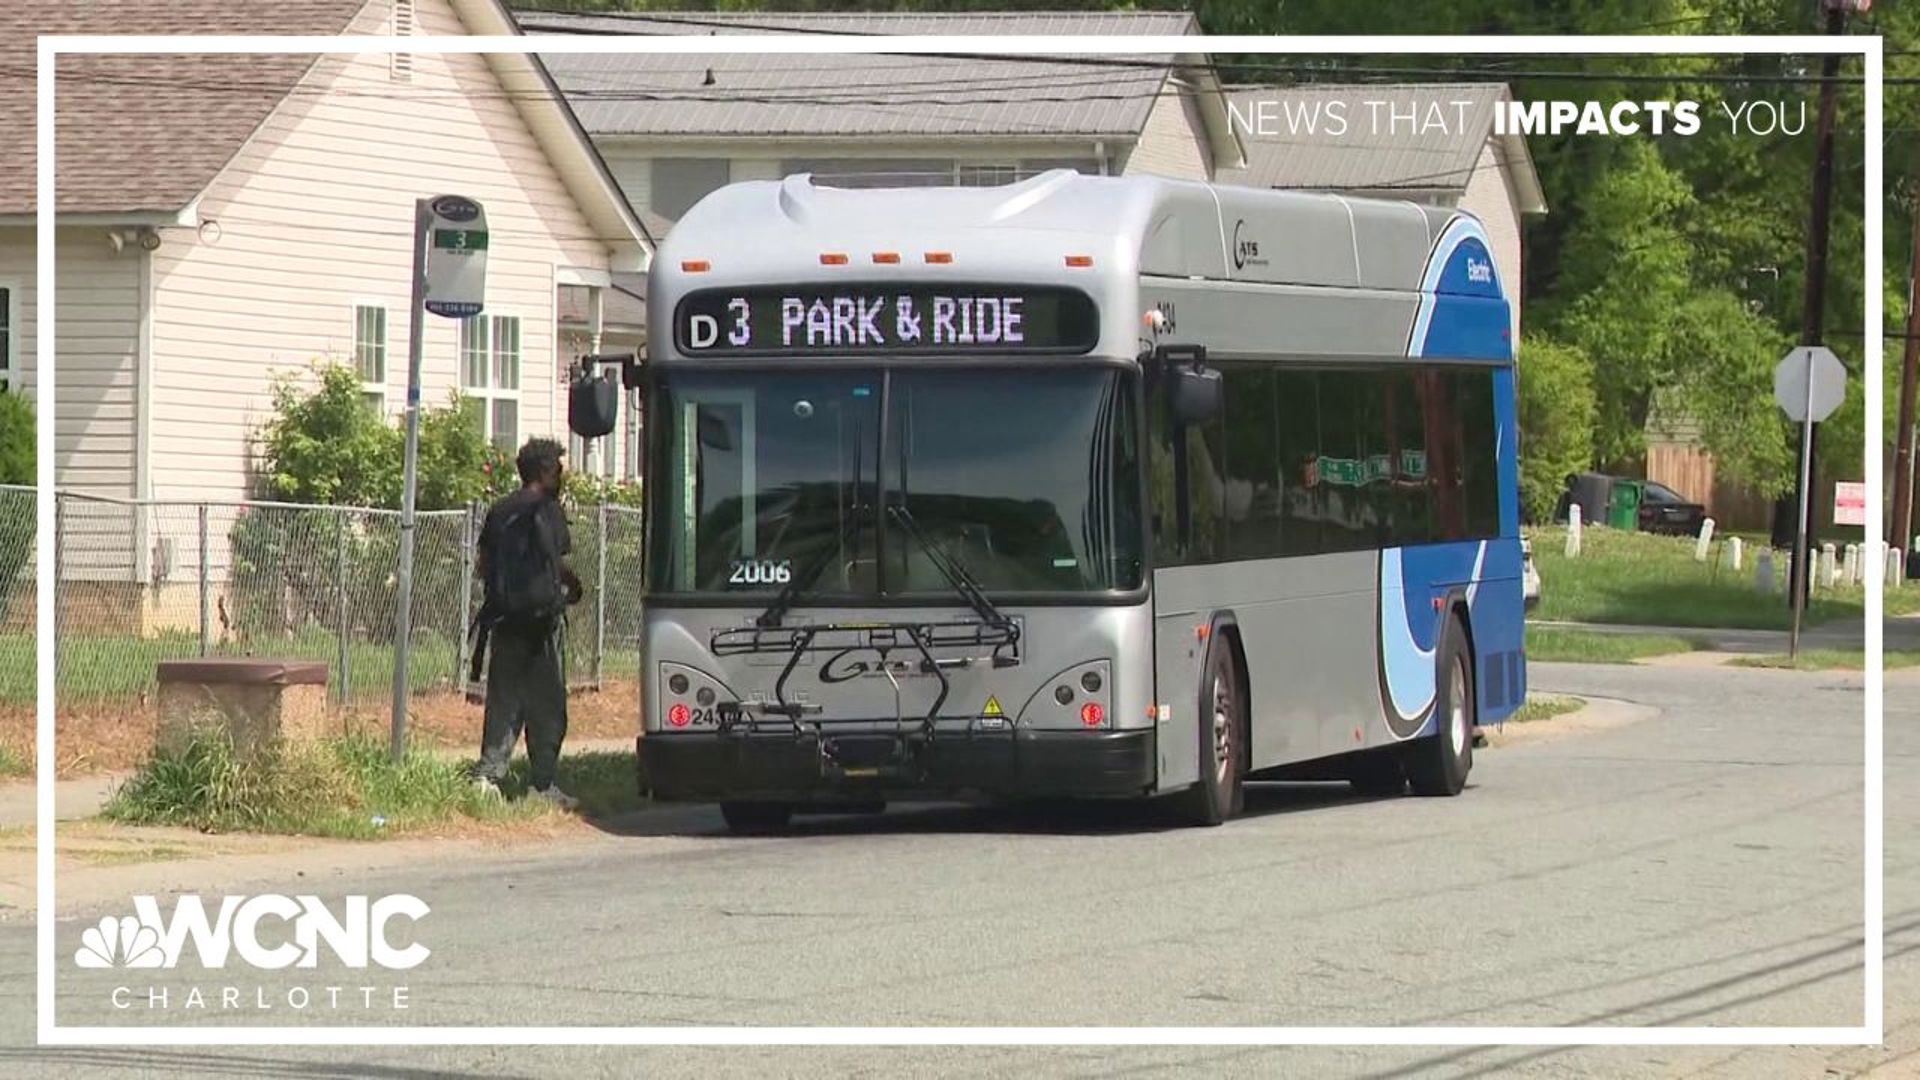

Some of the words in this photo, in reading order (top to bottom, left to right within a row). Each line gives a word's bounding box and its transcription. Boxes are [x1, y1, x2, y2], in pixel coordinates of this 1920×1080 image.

[455, 231, 467, 248] 3
[689, 315, 718, 348] D
[728, 298, 750, 346] 3
[782, 297, 885, 346] PARK
[896, 296, 921, 342] &
[933, 297, 1023, 344] RIDE
[729, 560, 792, 583] 2006
